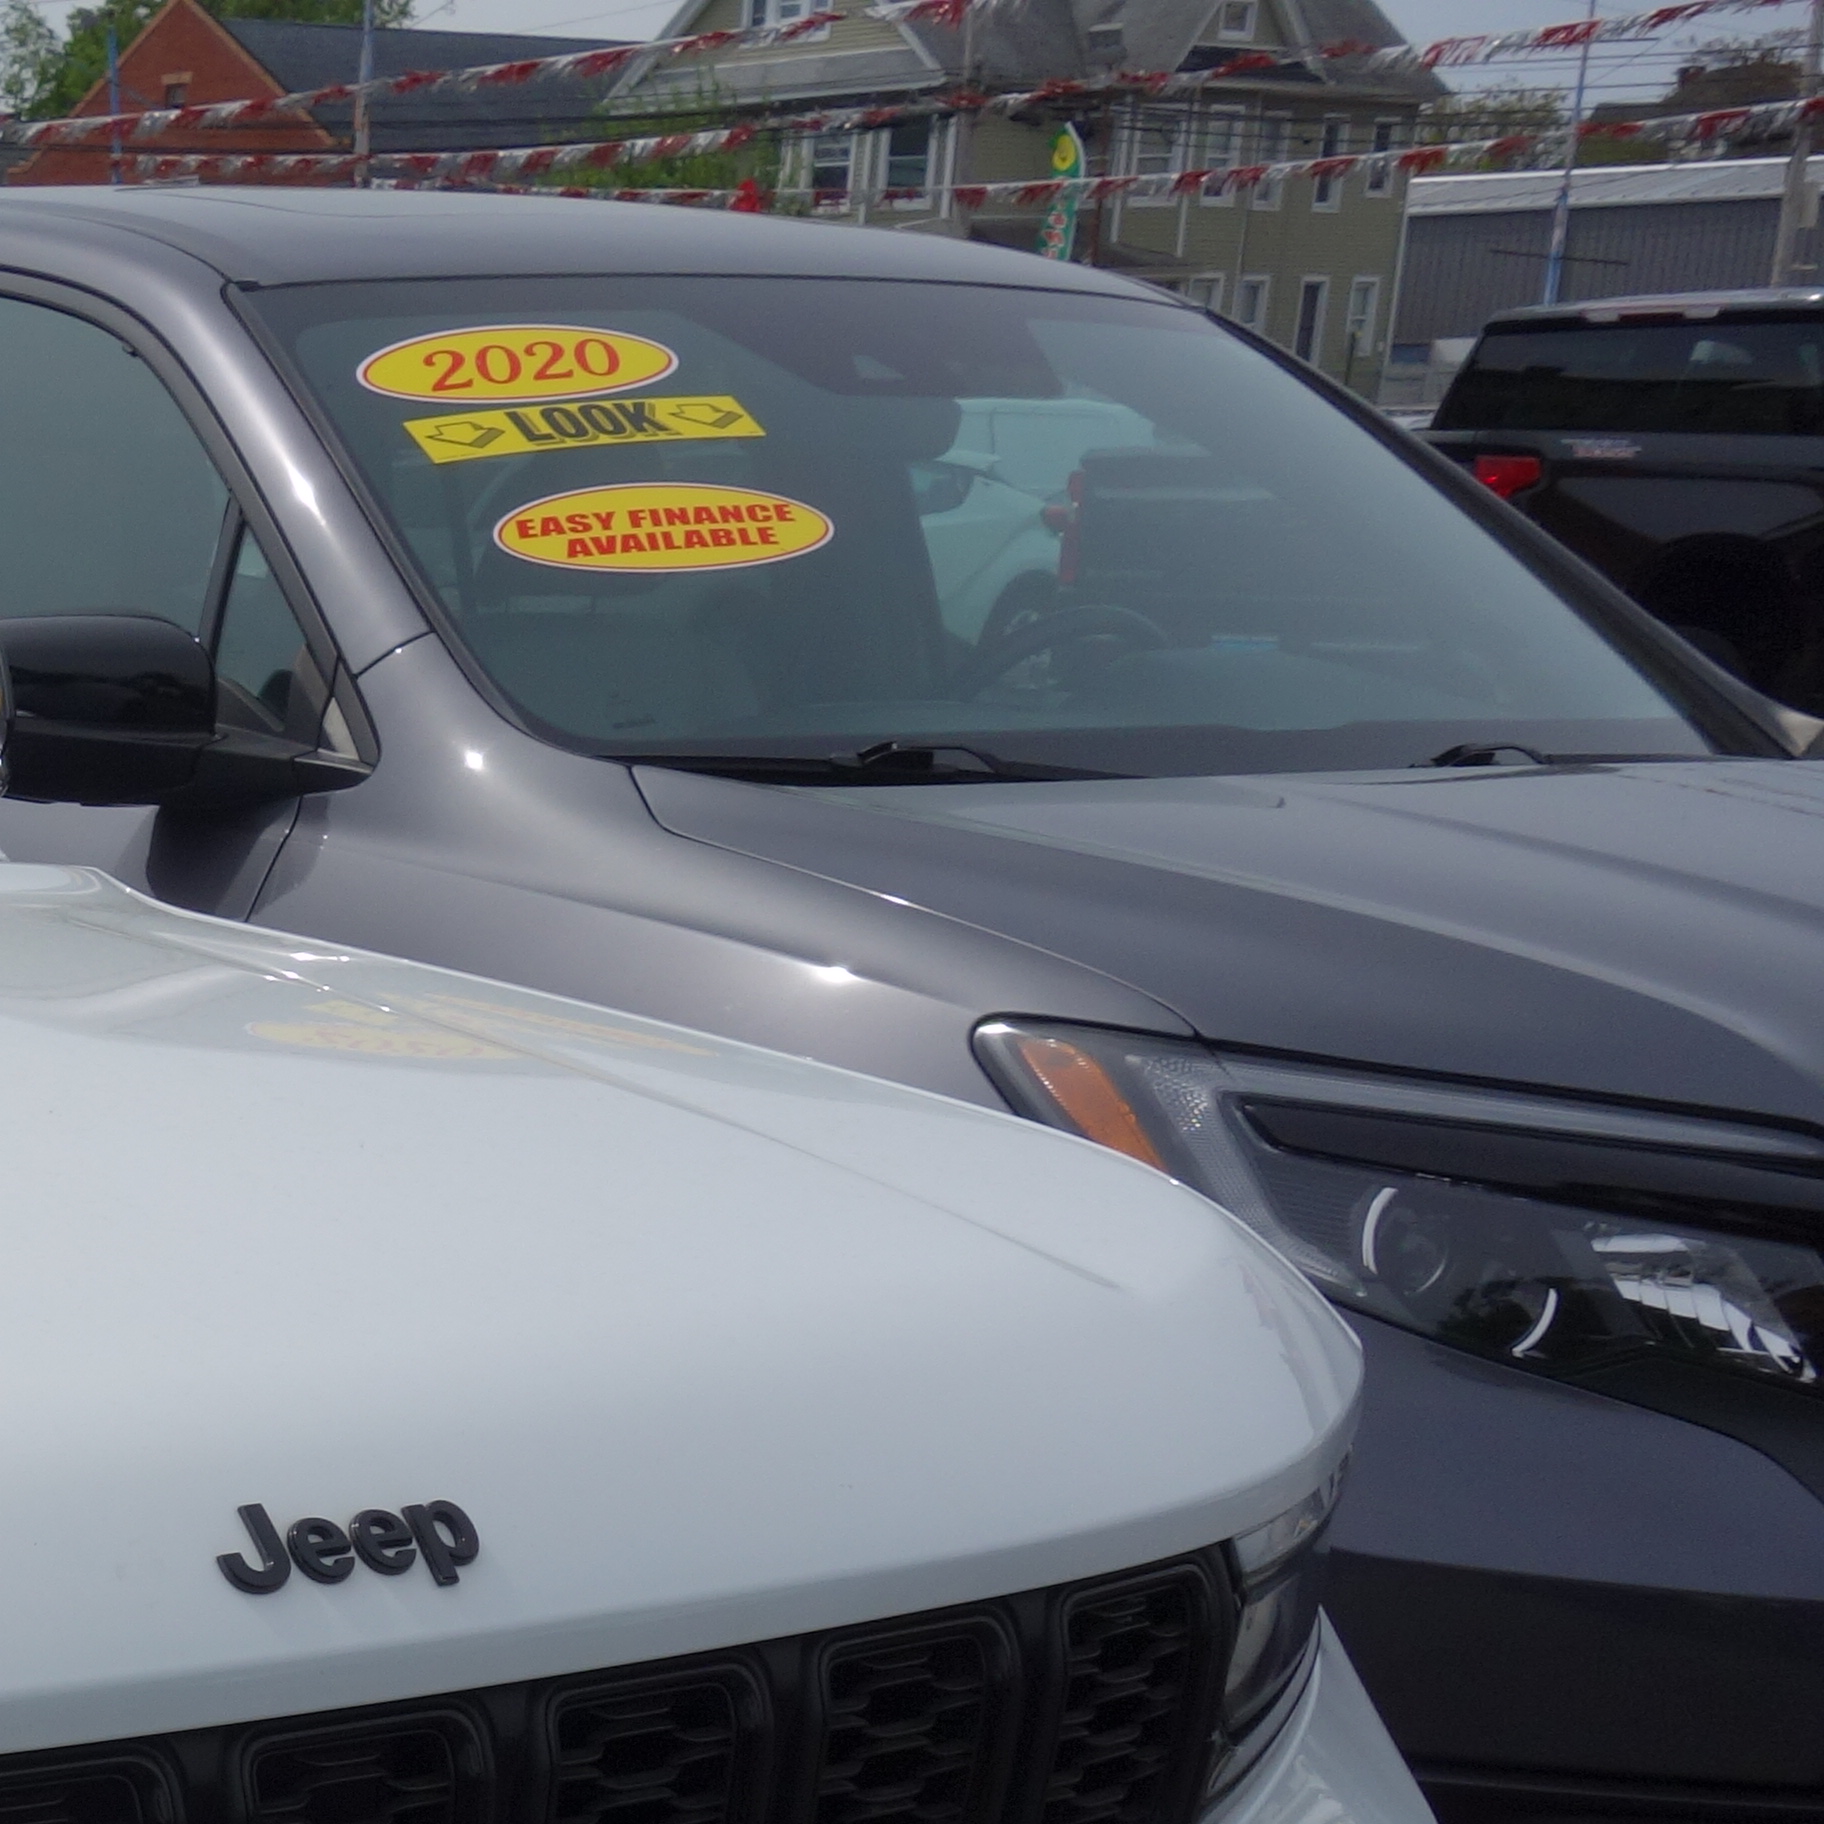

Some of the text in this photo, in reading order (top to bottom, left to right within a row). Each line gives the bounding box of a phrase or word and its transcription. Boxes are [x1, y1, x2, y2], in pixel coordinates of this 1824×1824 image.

[422, 338, 620, 392] 2020
[504, 400, 682, 447] LOOK
[515, 503, 796, 540] EASY FINANCE
[565, 526, 780, 559] AVAILABLE
[216, 1499, 480, 1595] Jeep
